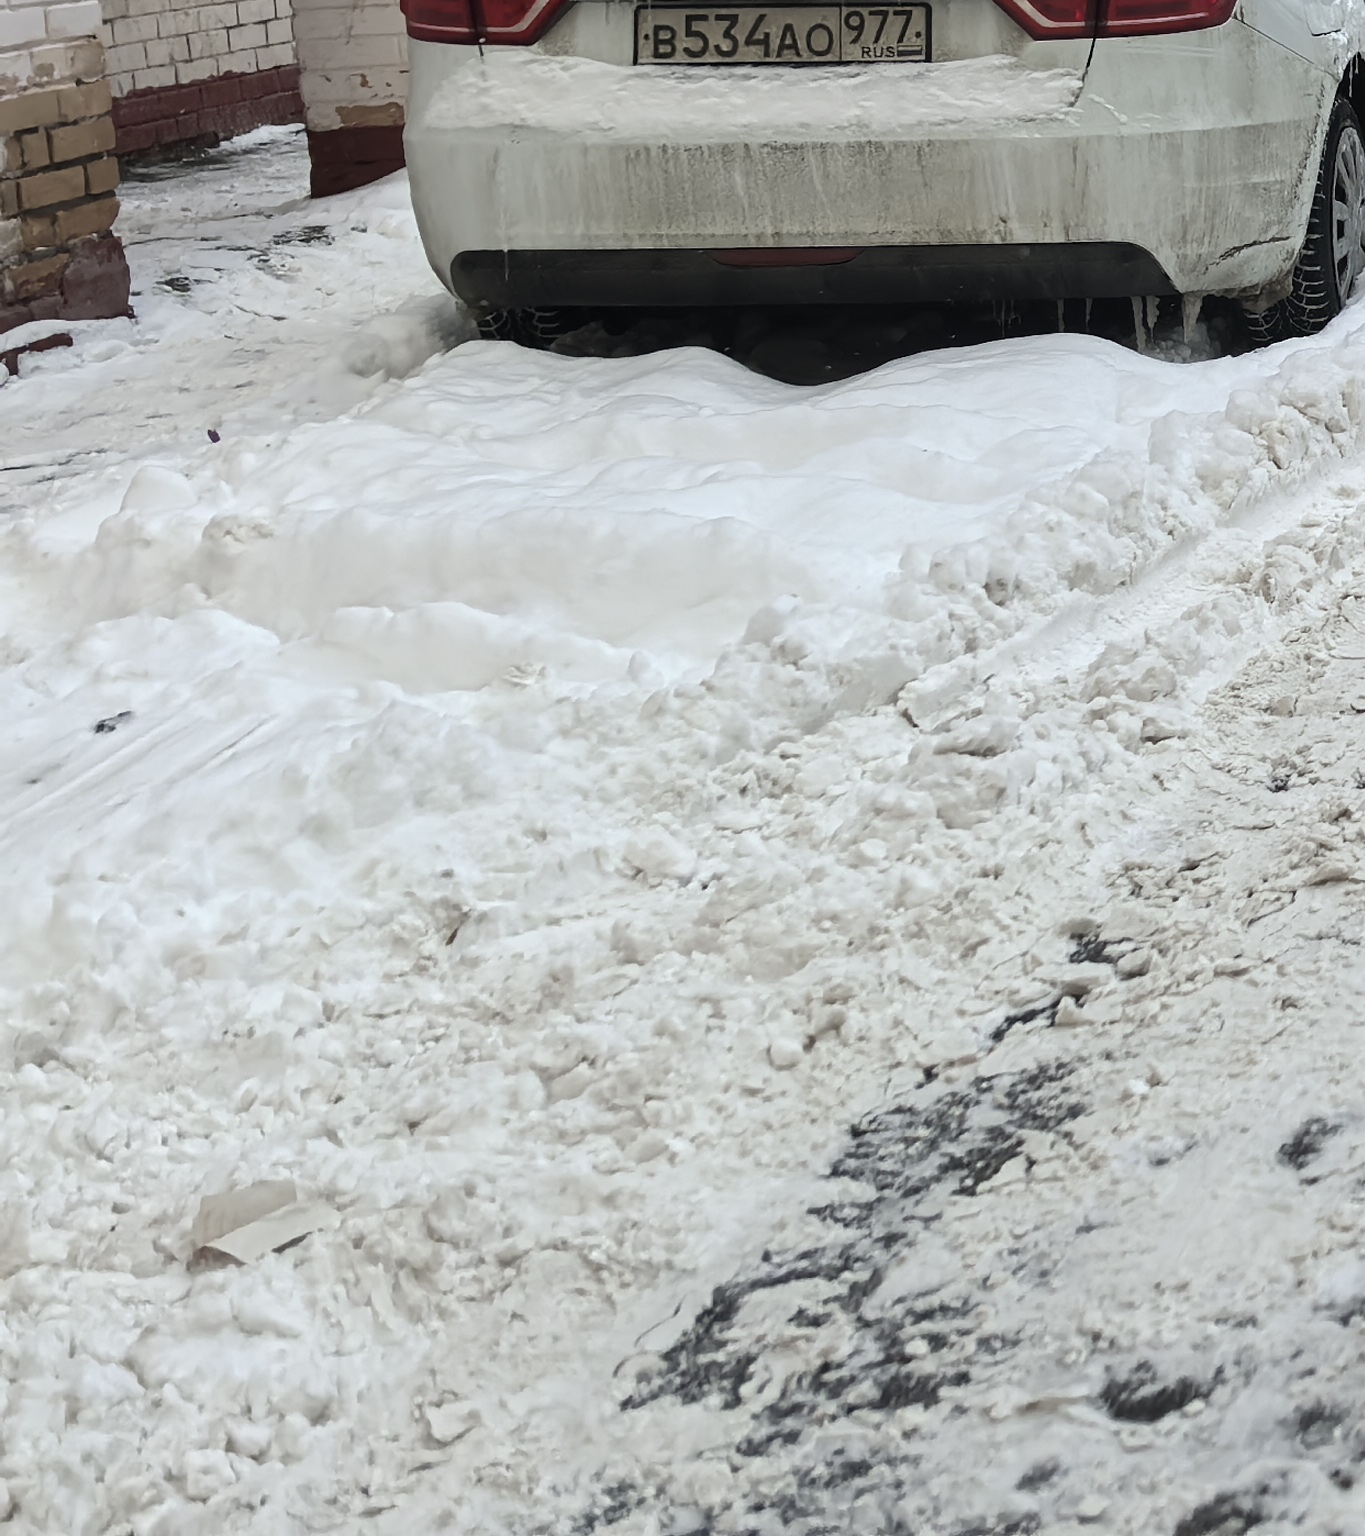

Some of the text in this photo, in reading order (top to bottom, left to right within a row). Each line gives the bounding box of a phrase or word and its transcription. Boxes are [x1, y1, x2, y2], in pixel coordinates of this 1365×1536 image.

[652, 9, 913, 59] В534АО 977
[861, 46, 895, 59] RUS
